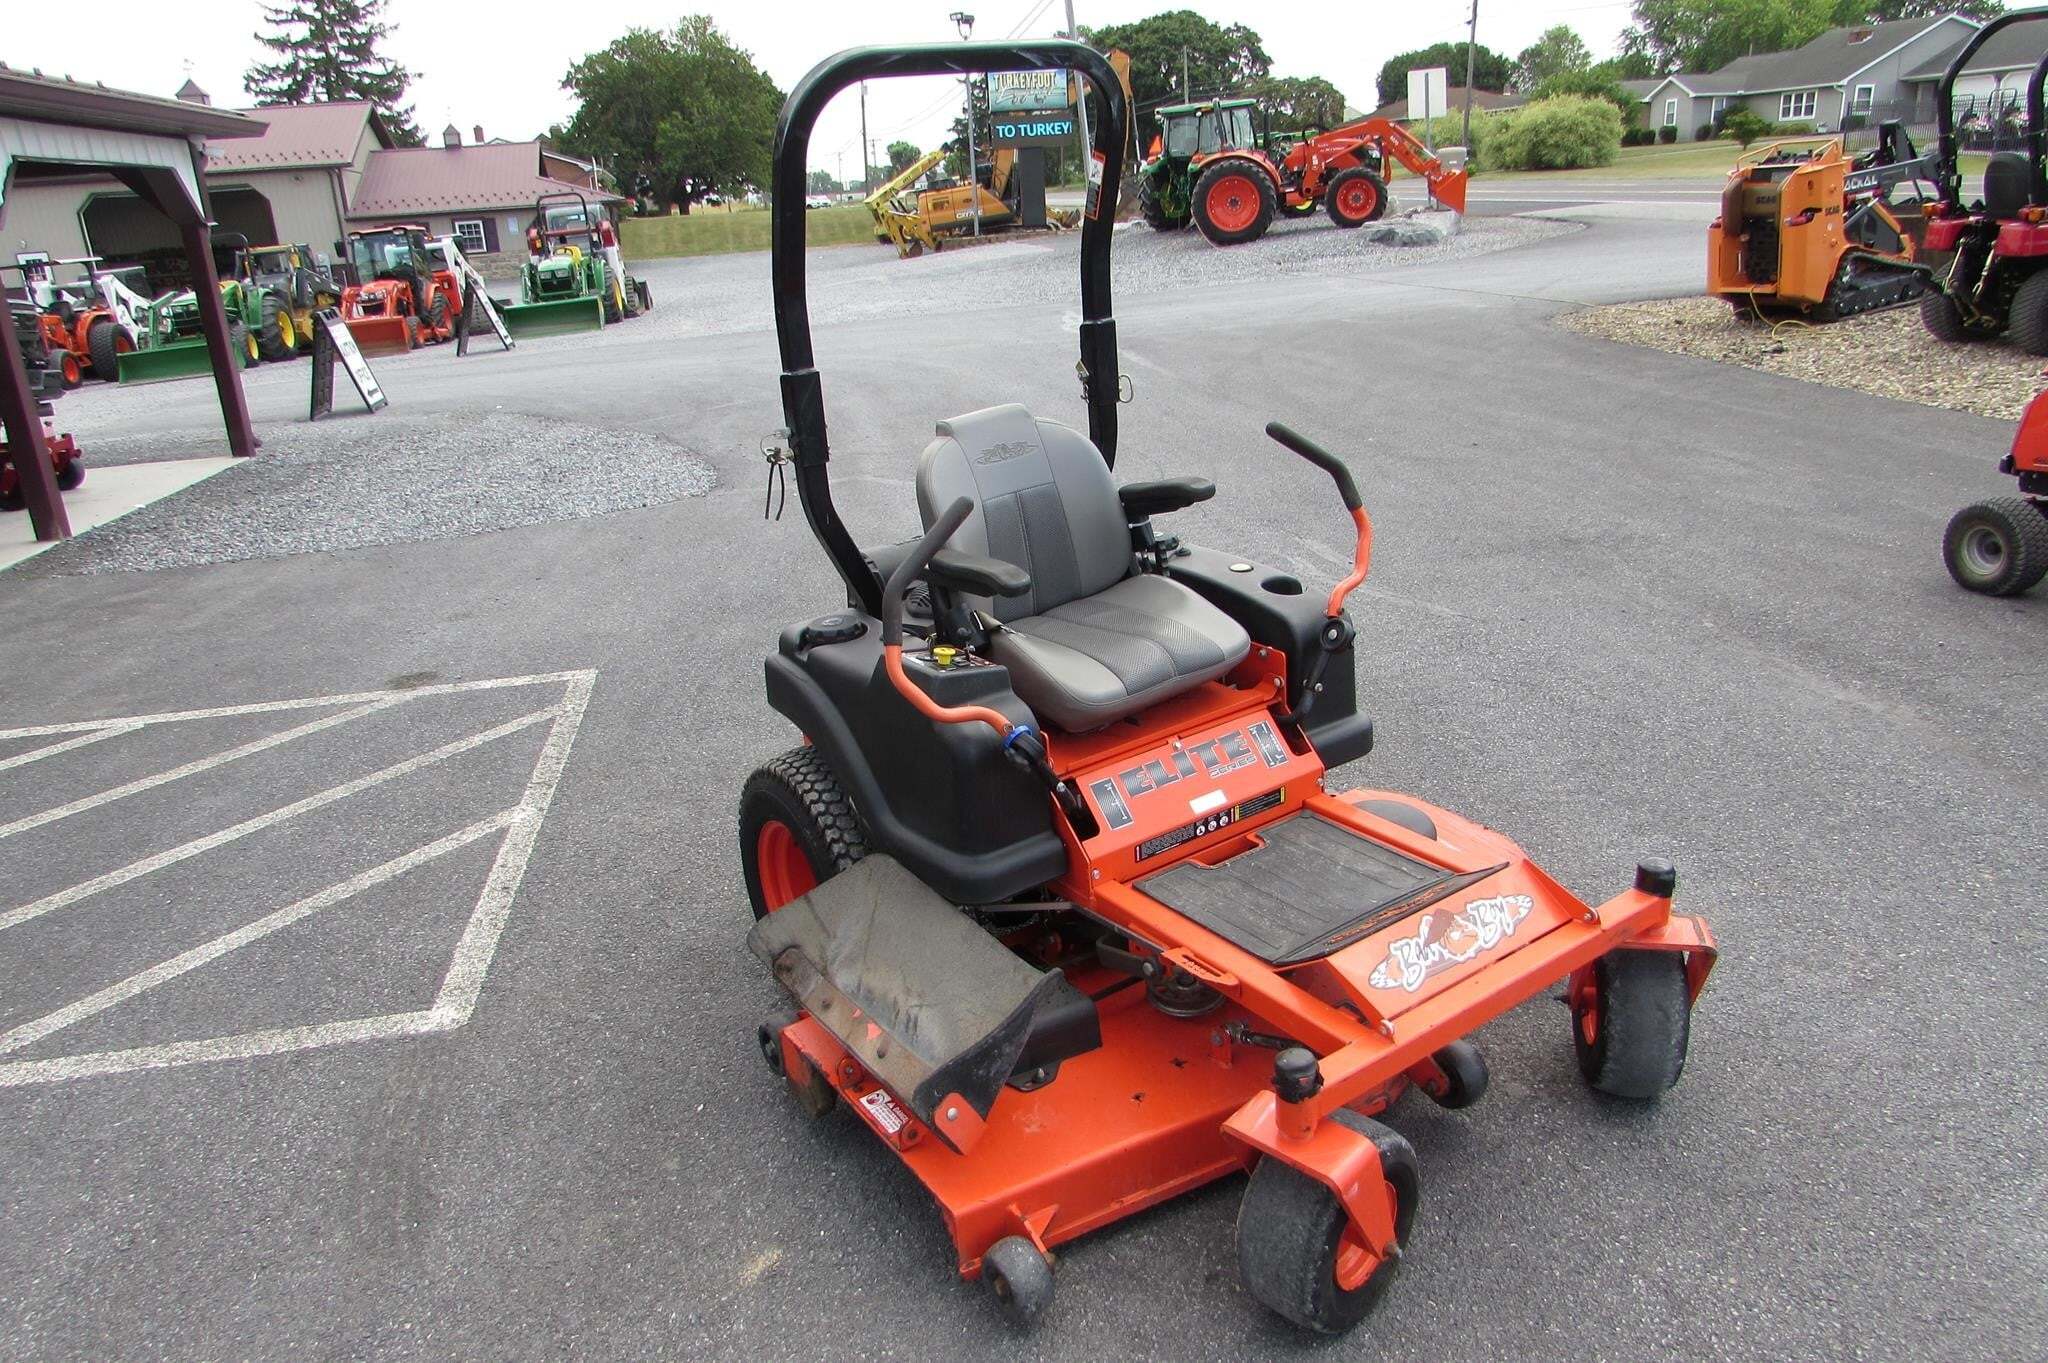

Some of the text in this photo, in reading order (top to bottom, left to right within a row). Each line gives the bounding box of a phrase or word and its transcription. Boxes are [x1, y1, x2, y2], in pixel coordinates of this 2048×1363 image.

[994, 71, 1057, 90] TURKEYFOOT
[996, 125, 1015, 138] TO
[1844, 175, 1878, 189] ACKAL
[1119, 729, 1252, 798] ELITE
